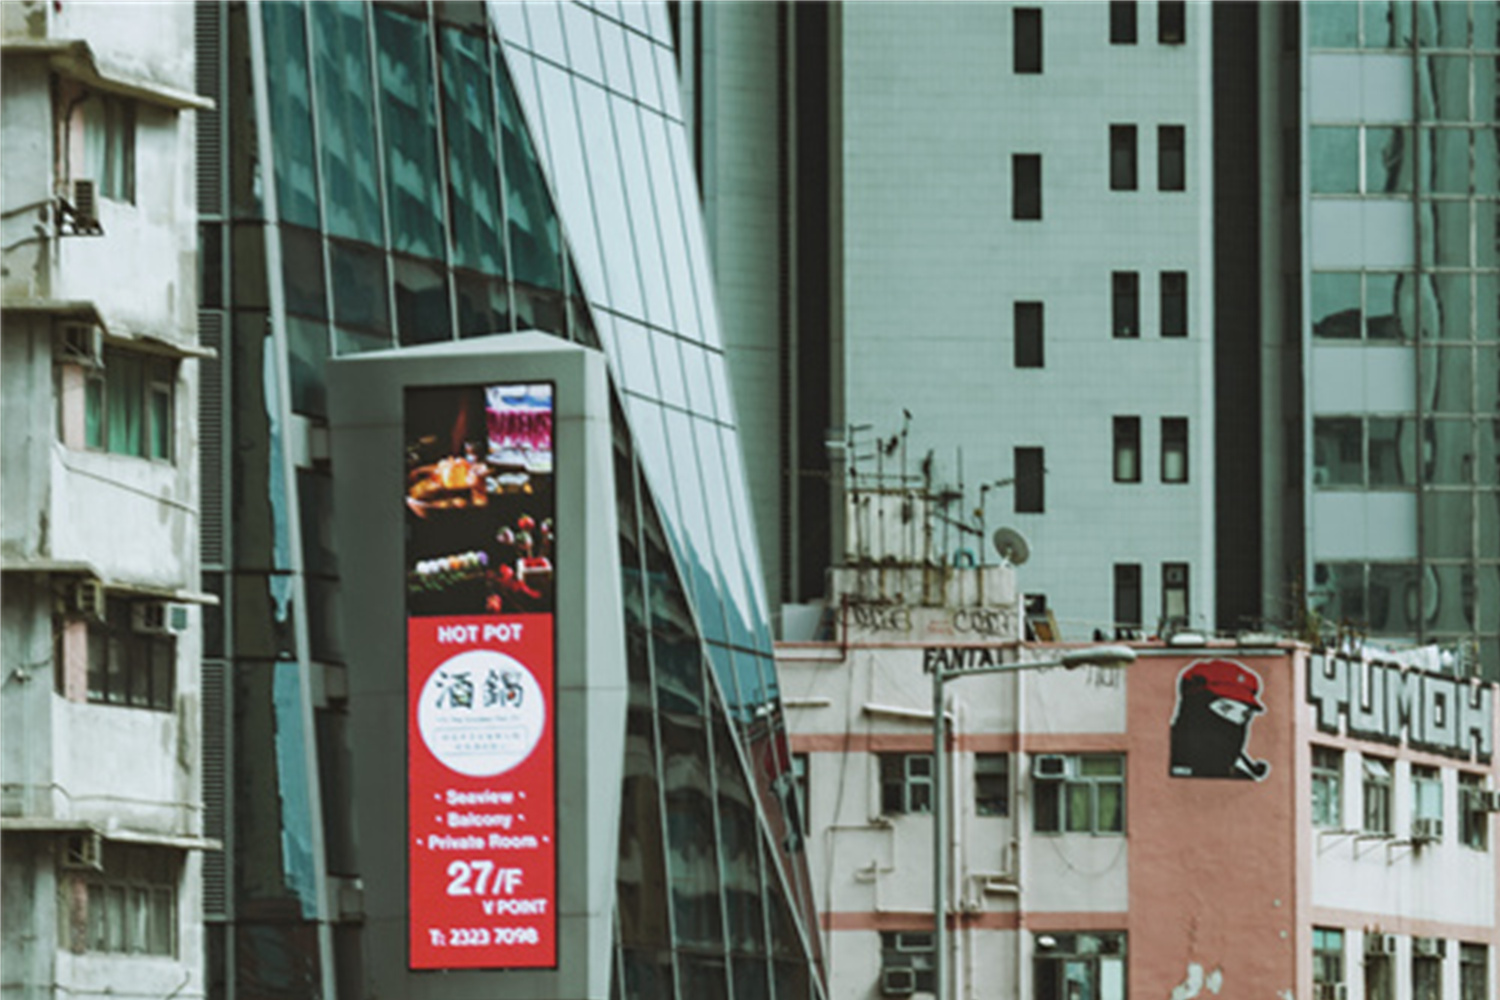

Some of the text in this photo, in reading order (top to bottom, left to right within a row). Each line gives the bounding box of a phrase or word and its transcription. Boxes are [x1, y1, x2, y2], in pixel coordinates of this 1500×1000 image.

[437, 622, 523, 643] HOT POT
[446, 789, 514, 805] Seaview
[447, 811, 513, 830] Balcony
[428, 832, 538, 850] Private Room
[446, 860, 523, 896] 27/F
[482, 898, 547, 915] V POINT
[428, 926, 539, 946] T: 2323 7098
